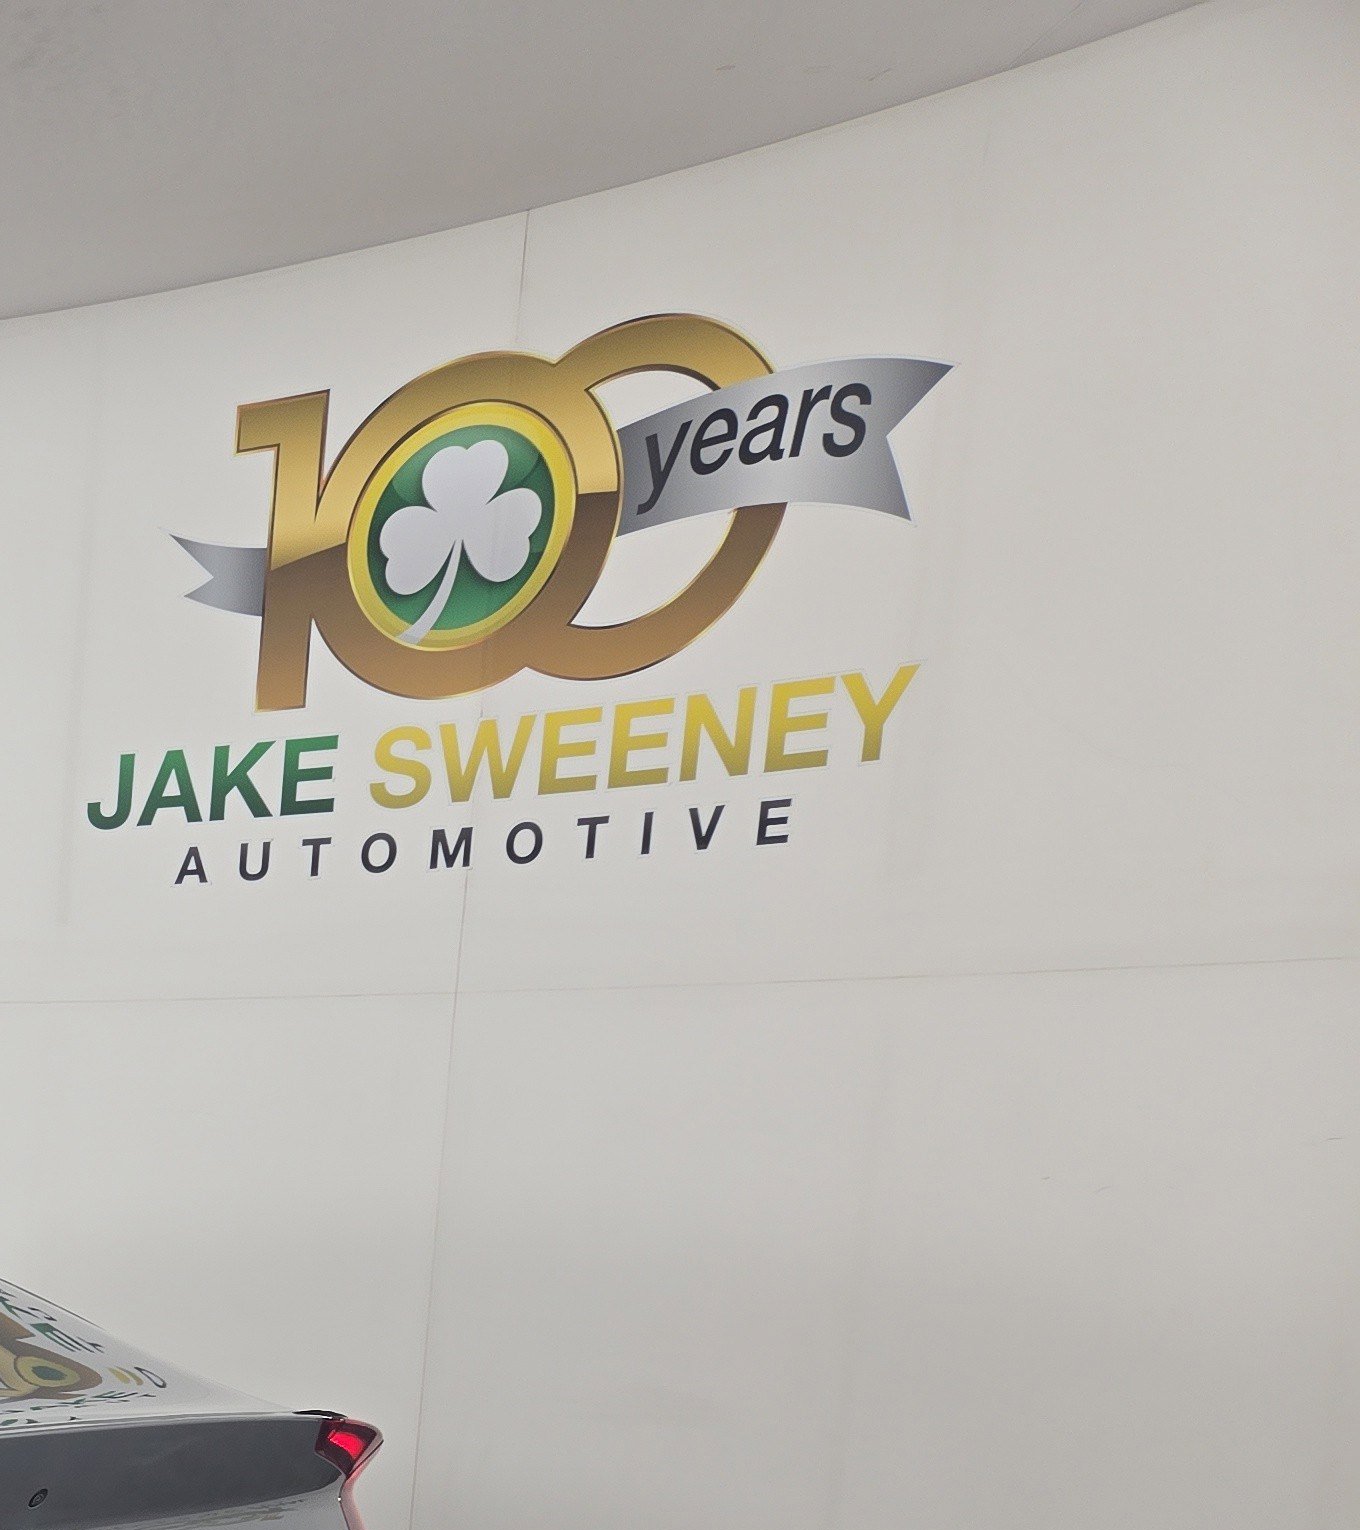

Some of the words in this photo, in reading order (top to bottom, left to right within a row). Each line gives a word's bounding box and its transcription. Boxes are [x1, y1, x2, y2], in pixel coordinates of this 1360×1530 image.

[636, 381, 872, 515] years
[88, 734, 339, 831] JAKE
[369, 663, 920, 810] SWEENEY
[174, 799, 792, 885] AUTOMOTIVE
